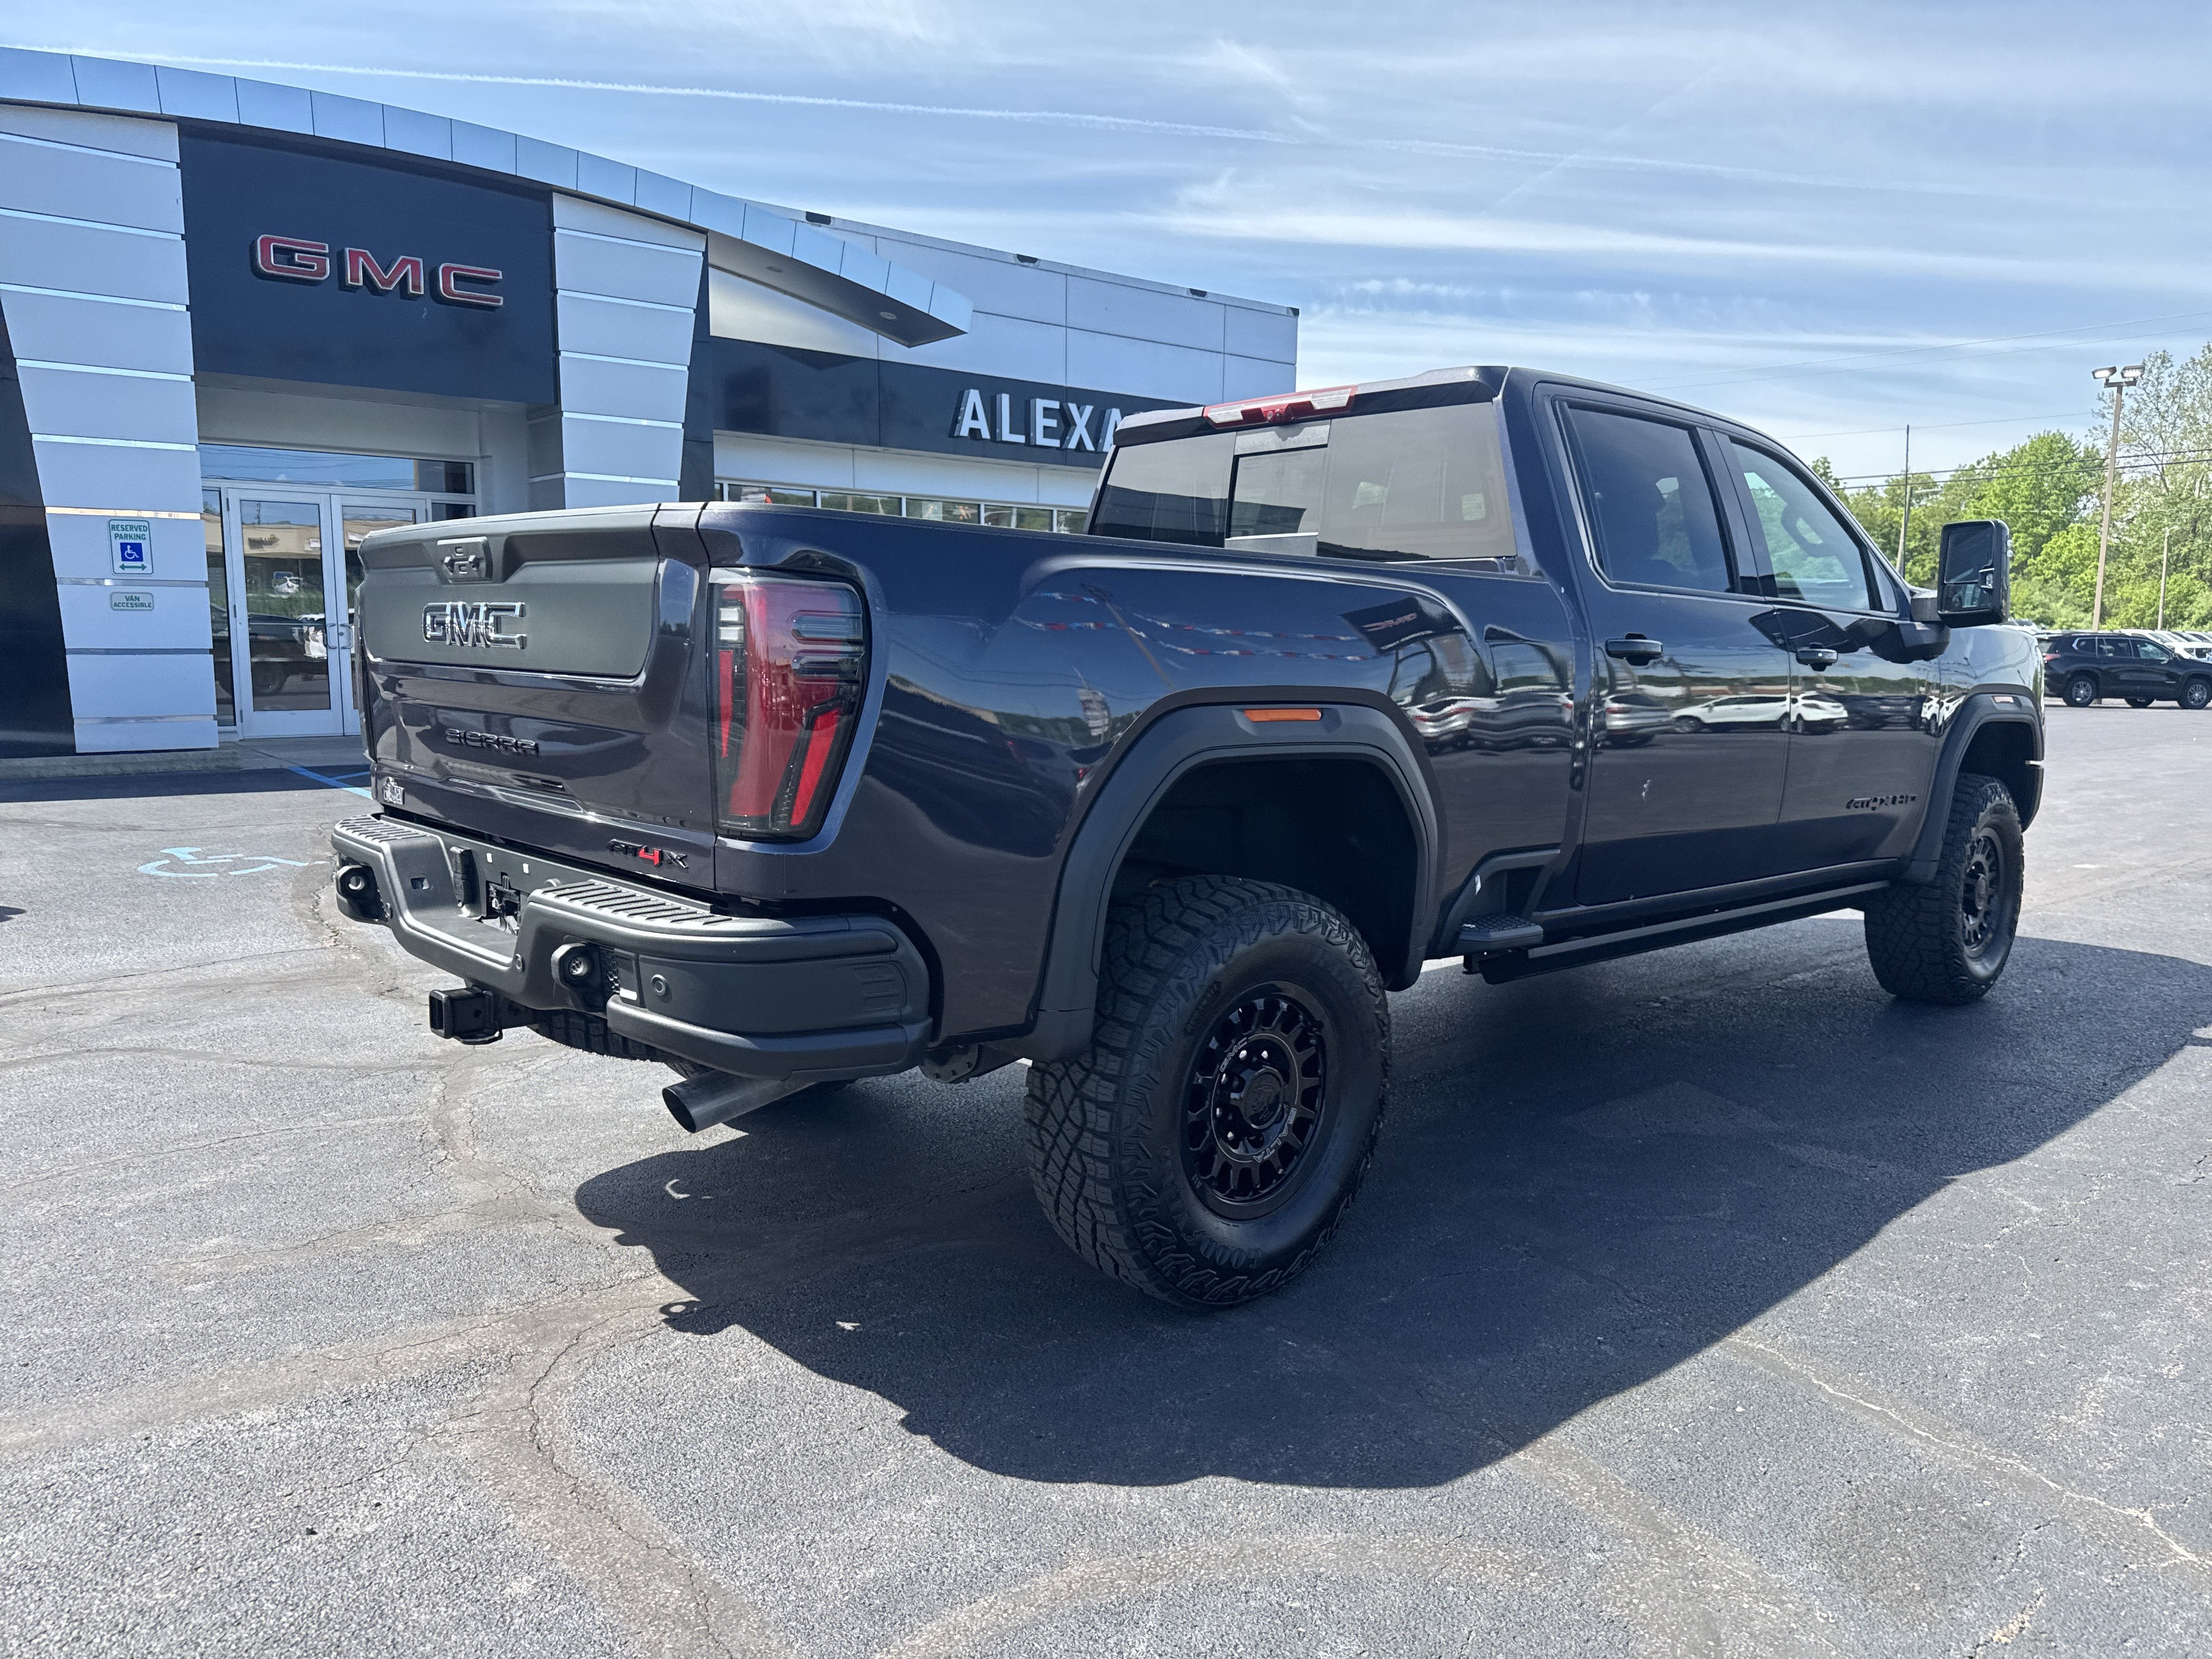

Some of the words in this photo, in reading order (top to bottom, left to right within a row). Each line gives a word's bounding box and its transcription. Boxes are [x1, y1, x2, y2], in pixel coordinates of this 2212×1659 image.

[257, 234, 504, 306] GMC
[111, 524, 148, 532] RESERVED
[422, 601, 527, 650] GMC
[445, 728, 540, 756] SIERRA
[606, 838, 690, 870] AT4X
[1220, 1037, 1248, 1073] GMC
